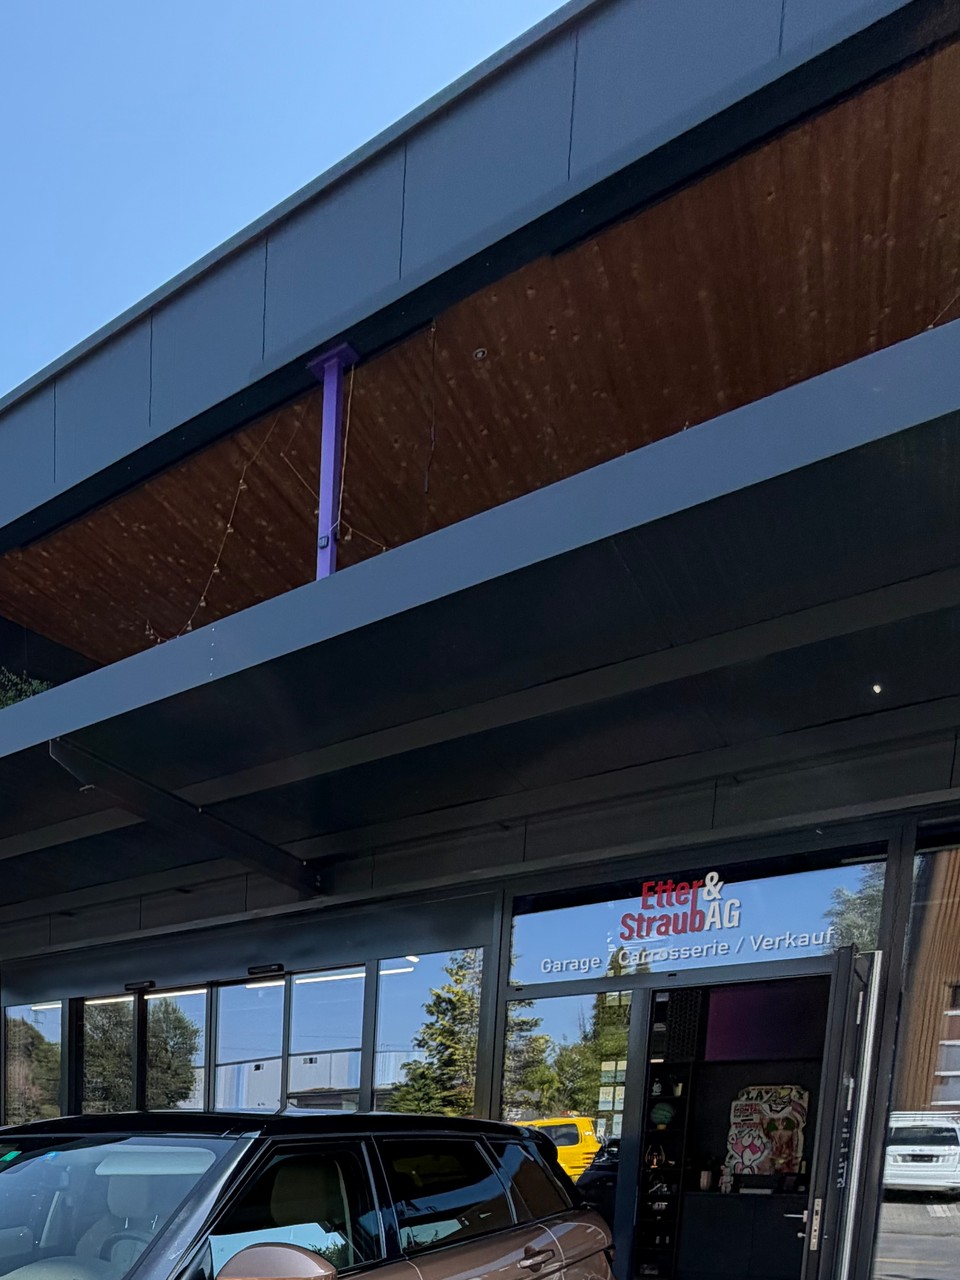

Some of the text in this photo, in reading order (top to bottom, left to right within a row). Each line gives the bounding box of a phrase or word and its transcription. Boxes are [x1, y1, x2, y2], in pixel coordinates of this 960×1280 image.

[641, 871, 724, 910] Etter &
[620, 899, 740, 940] Straub AG
[540, 954, 602, 974] Garage
[618, 940, 729, 965] Carrosserie
[749, 926, 836, 952] Verkauf
